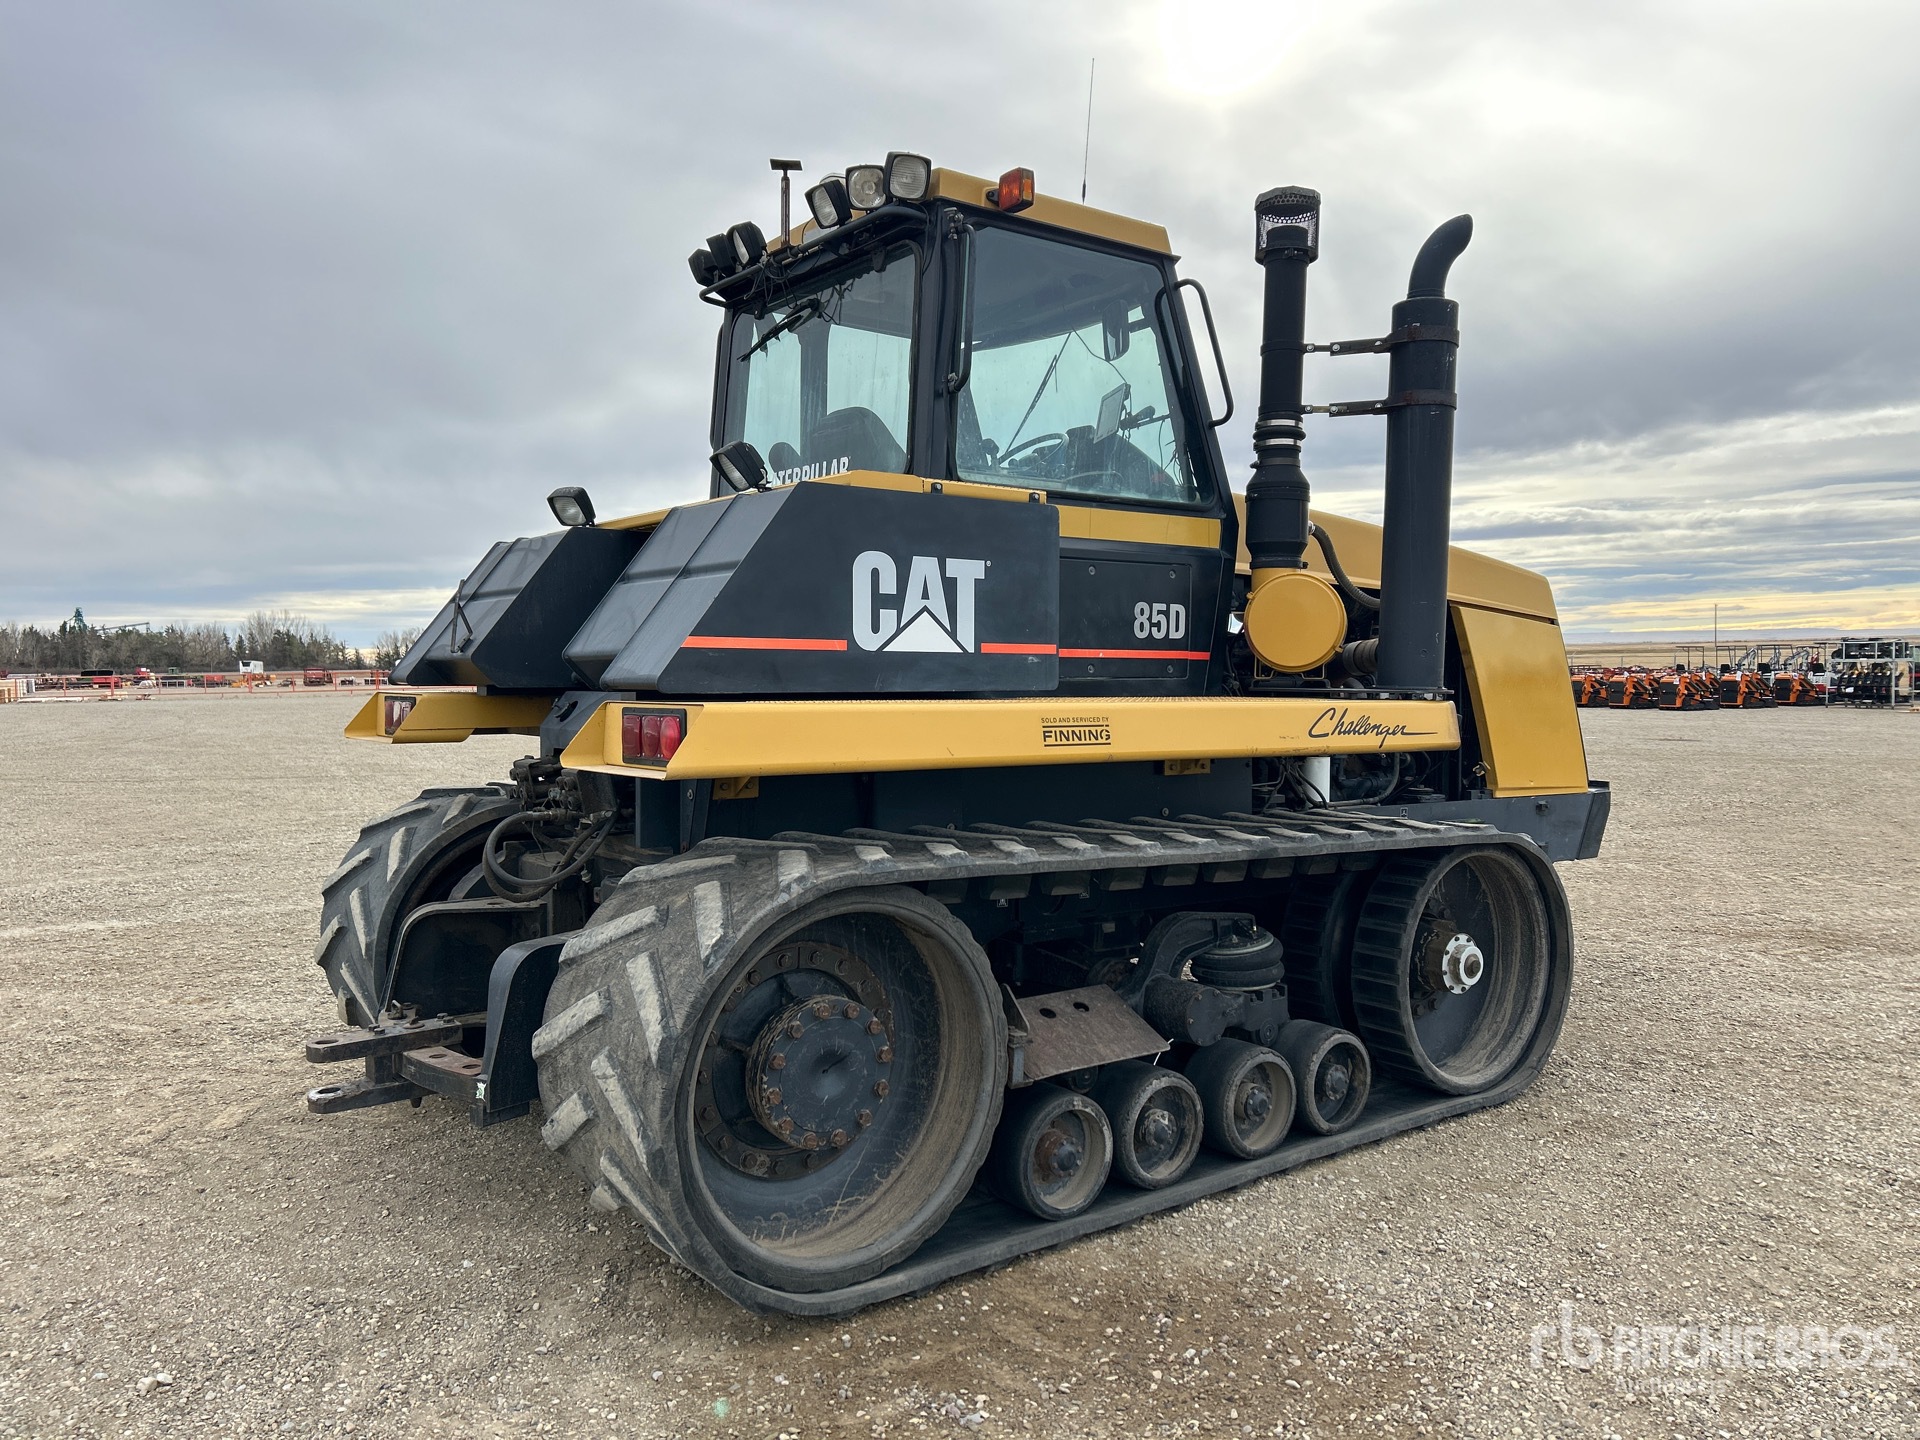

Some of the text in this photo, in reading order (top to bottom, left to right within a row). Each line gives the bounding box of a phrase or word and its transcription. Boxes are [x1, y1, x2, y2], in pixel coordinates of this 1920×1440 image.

[767, 456, 849, 487] ATERPILLAR
[852, 550, 986, 653] CAT
[1133, 601, 1186, 640] 85D
[1042, 729, 1111, 742] FINNING
[1308, 707, 1438, 749] Challenger
